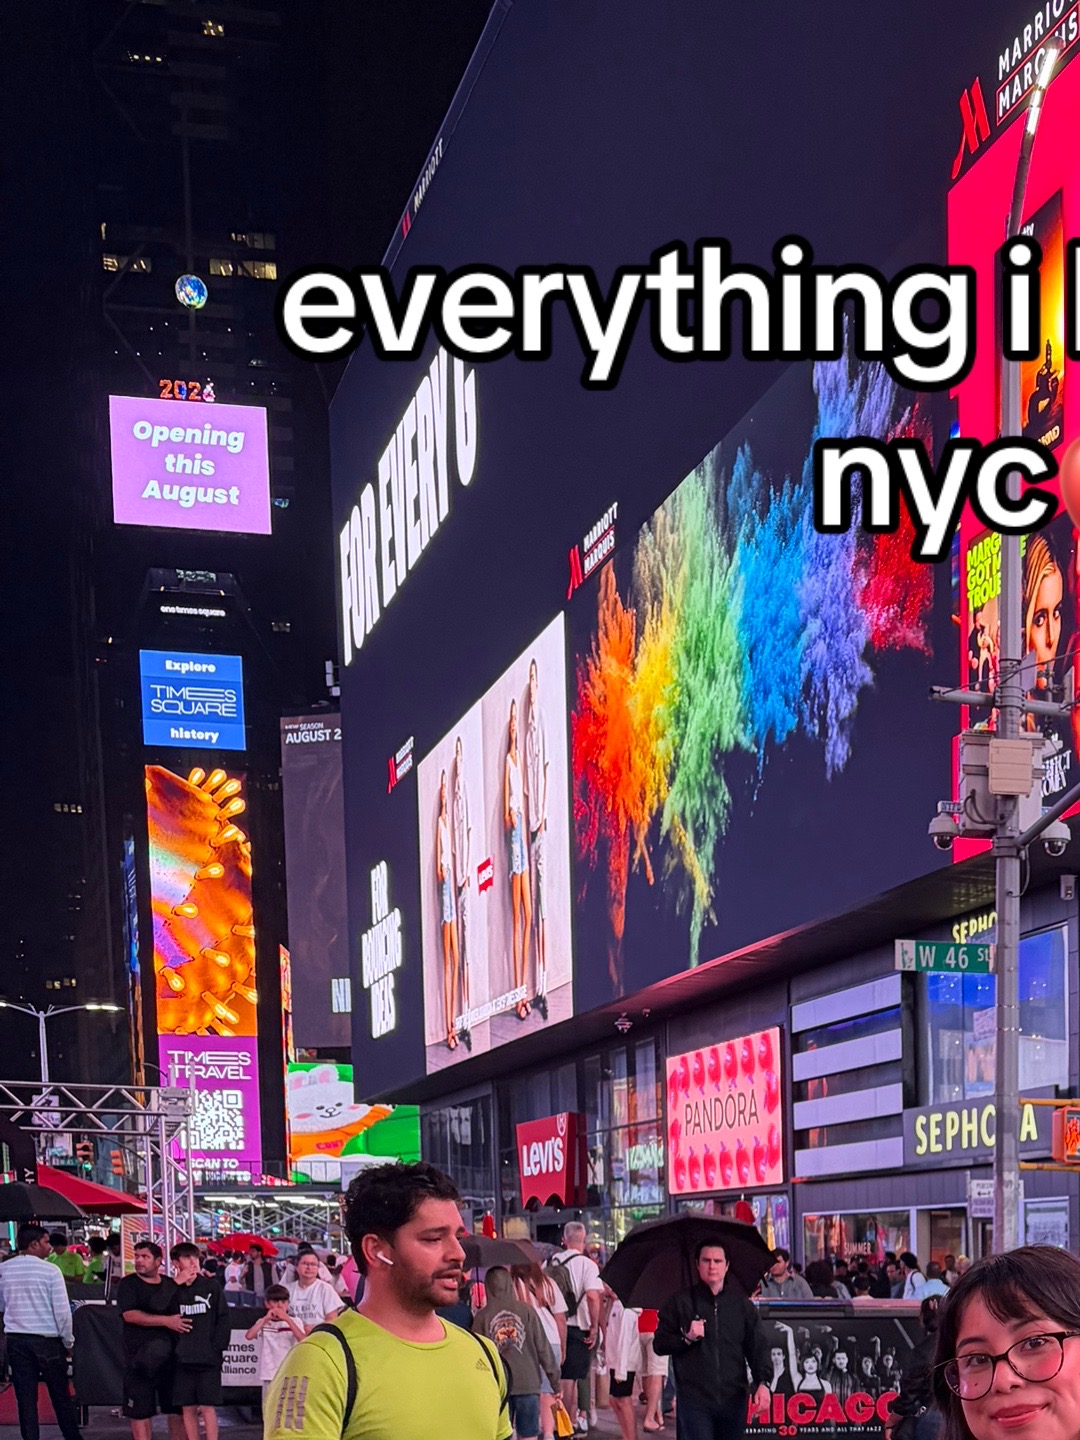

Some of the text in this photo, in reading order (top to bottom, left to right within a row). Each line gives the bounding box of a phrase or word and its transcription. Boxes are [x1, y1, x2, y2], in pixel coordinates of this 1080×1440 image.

[133, 420, 245, 453] Opening
[165, 453, 215, 476] this
[142, 480, 240, 508] August
[340, 482, 380, 667] FOR
[165, 659, 216, 674] Explore
[150, 684, 237, 703] TIMES
[151, 699, 238, 718] SQUARE
[170, 727, 220, 744] history
[300, 722, 324, 730] SEASON
[285, 730, 331, 744] AUGUST
[918, 945, 936, 968] W
[944, 946, 969, 969] 46
[167, 1050, 252, 1065] TIMES
[684, 1087, 760, 1136] PANDORA
[915, 1103, 1038, 1155] SEPHOA
[223, 1158, 239, 1169] TO
[778, 1425, 798, 1437] 30
